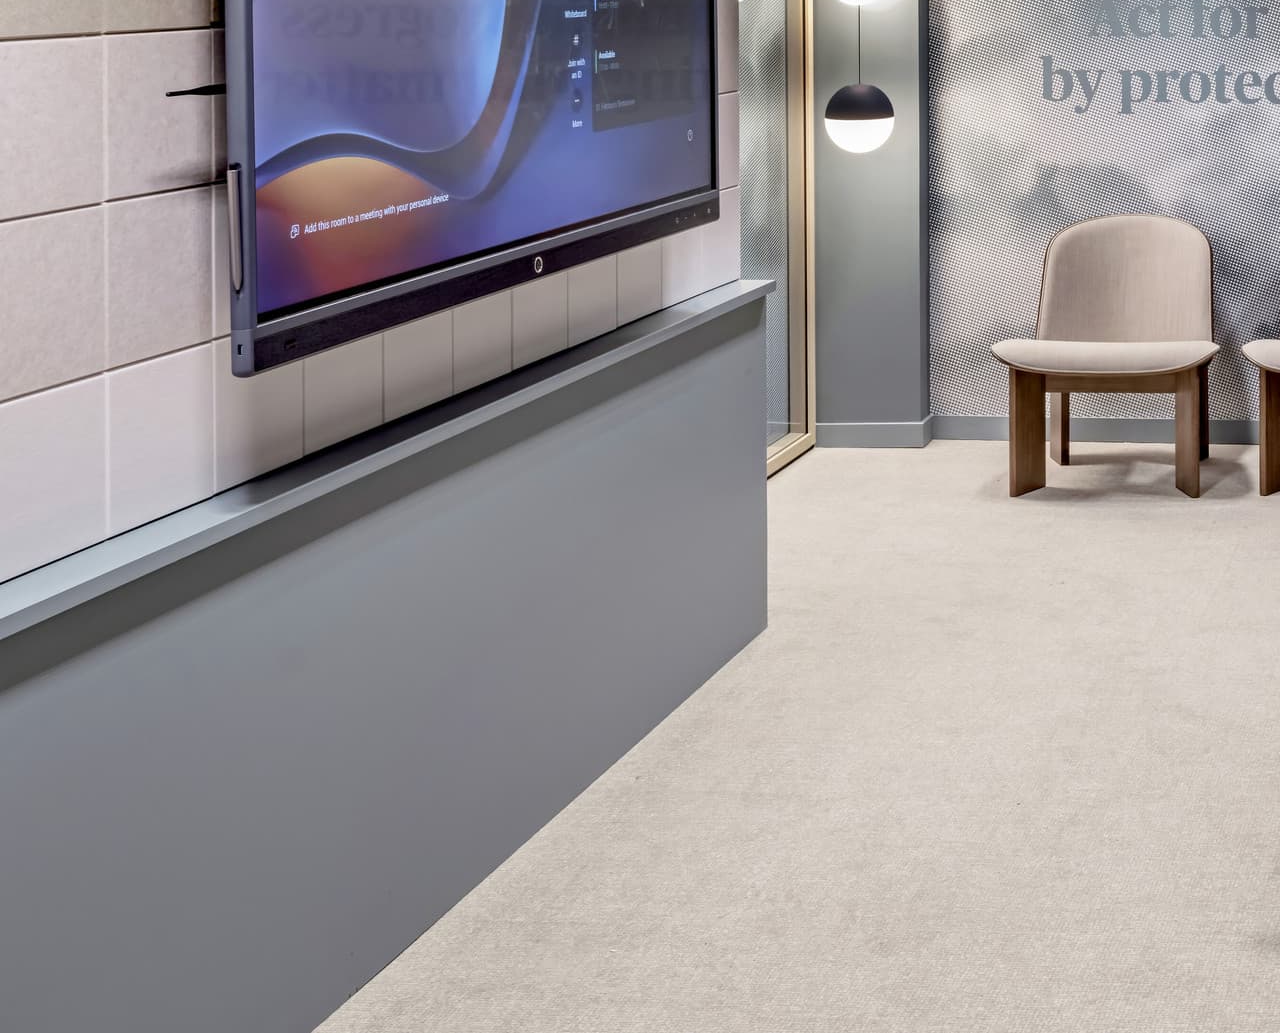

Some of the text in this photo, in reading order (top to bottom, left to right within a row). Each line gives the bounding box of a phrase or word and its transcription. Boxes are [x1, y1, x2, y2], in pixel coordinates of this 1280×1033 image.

[1040, 56, 1104, 113] by
[304, 193, 449, 234] Add this room to a meeting with your personal device
